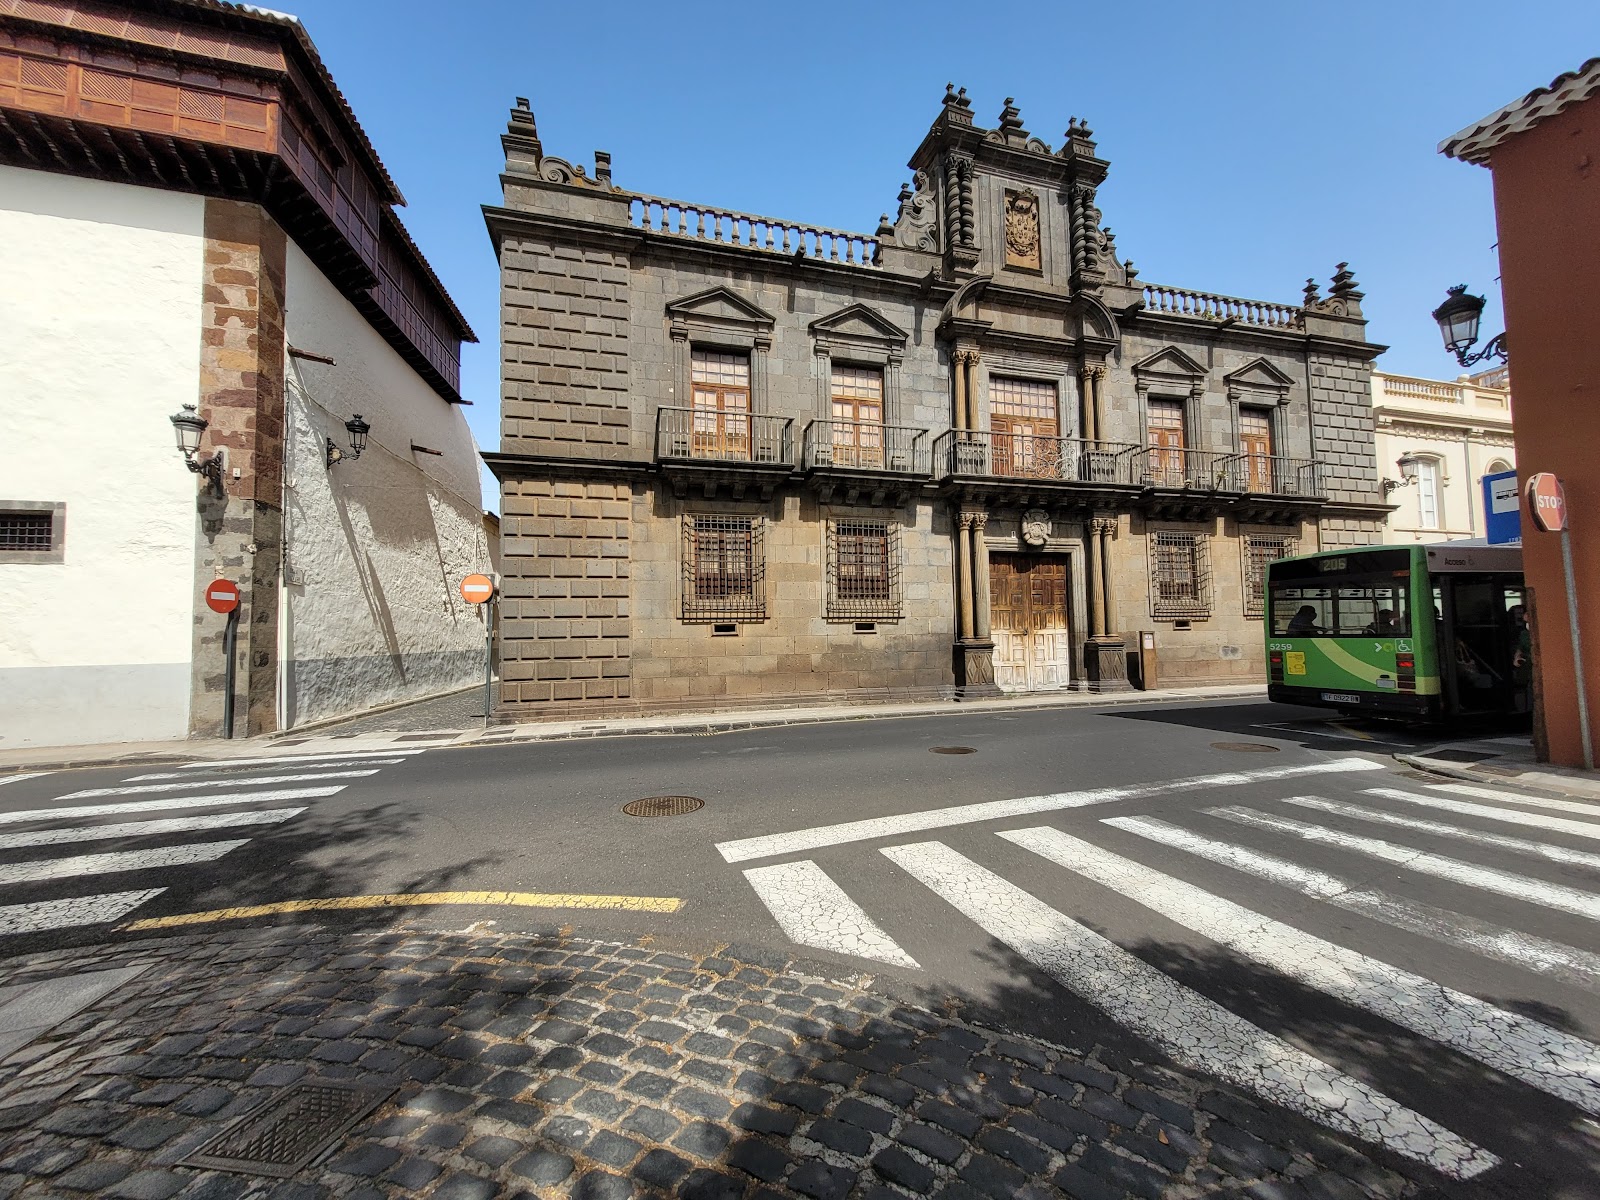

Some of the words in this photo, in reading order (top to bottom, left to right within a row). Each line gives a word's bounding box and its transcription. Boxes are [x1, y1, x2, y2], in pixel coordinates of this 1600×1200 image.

[1538, 495, 1562, 509] STOP
[1445, 557, 1466, 566] Acceso
[1270, 643, 1292, 651] 5259
